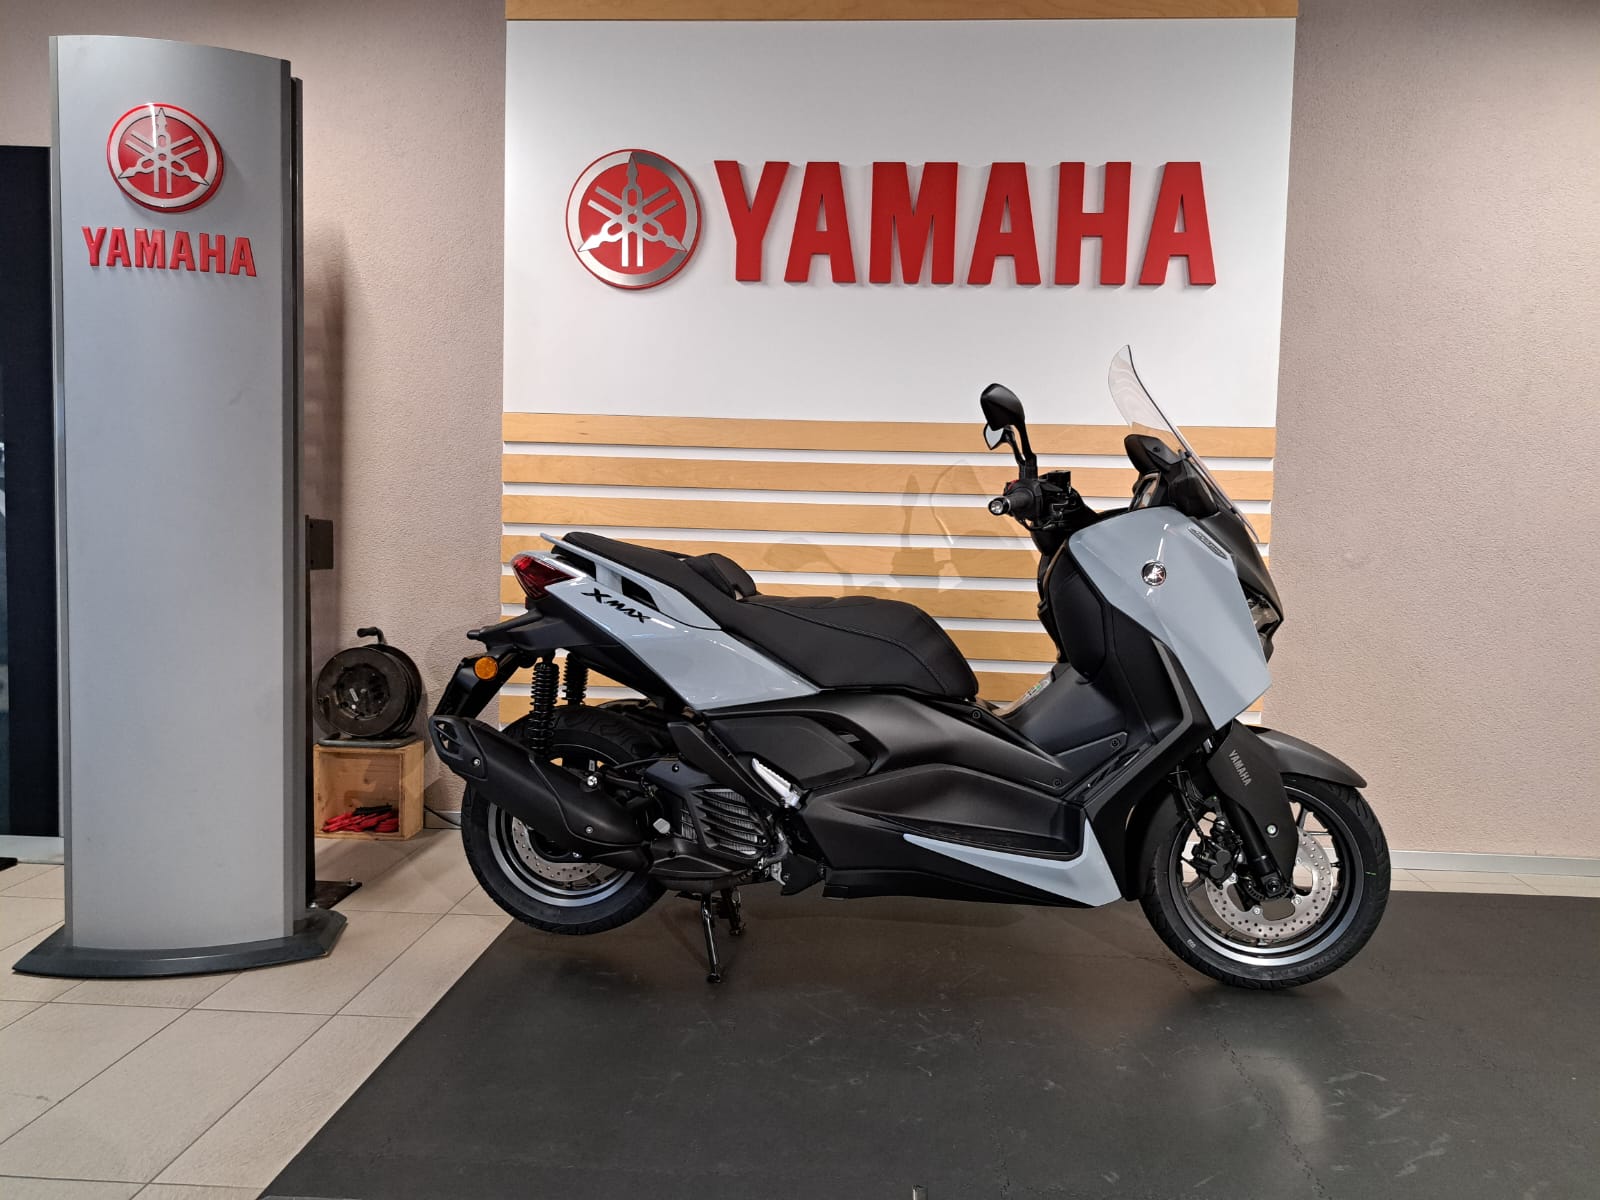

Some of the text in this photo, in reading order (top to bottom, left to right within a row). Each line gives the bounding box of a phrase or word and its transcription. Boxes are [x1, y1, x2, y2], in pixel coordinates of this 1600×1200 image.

[713, 160, 1216, 286] YAMAHA
[81, 226, 256, 277] YAMAHA
[1228, 749, 1252, 786] YAMAHA
